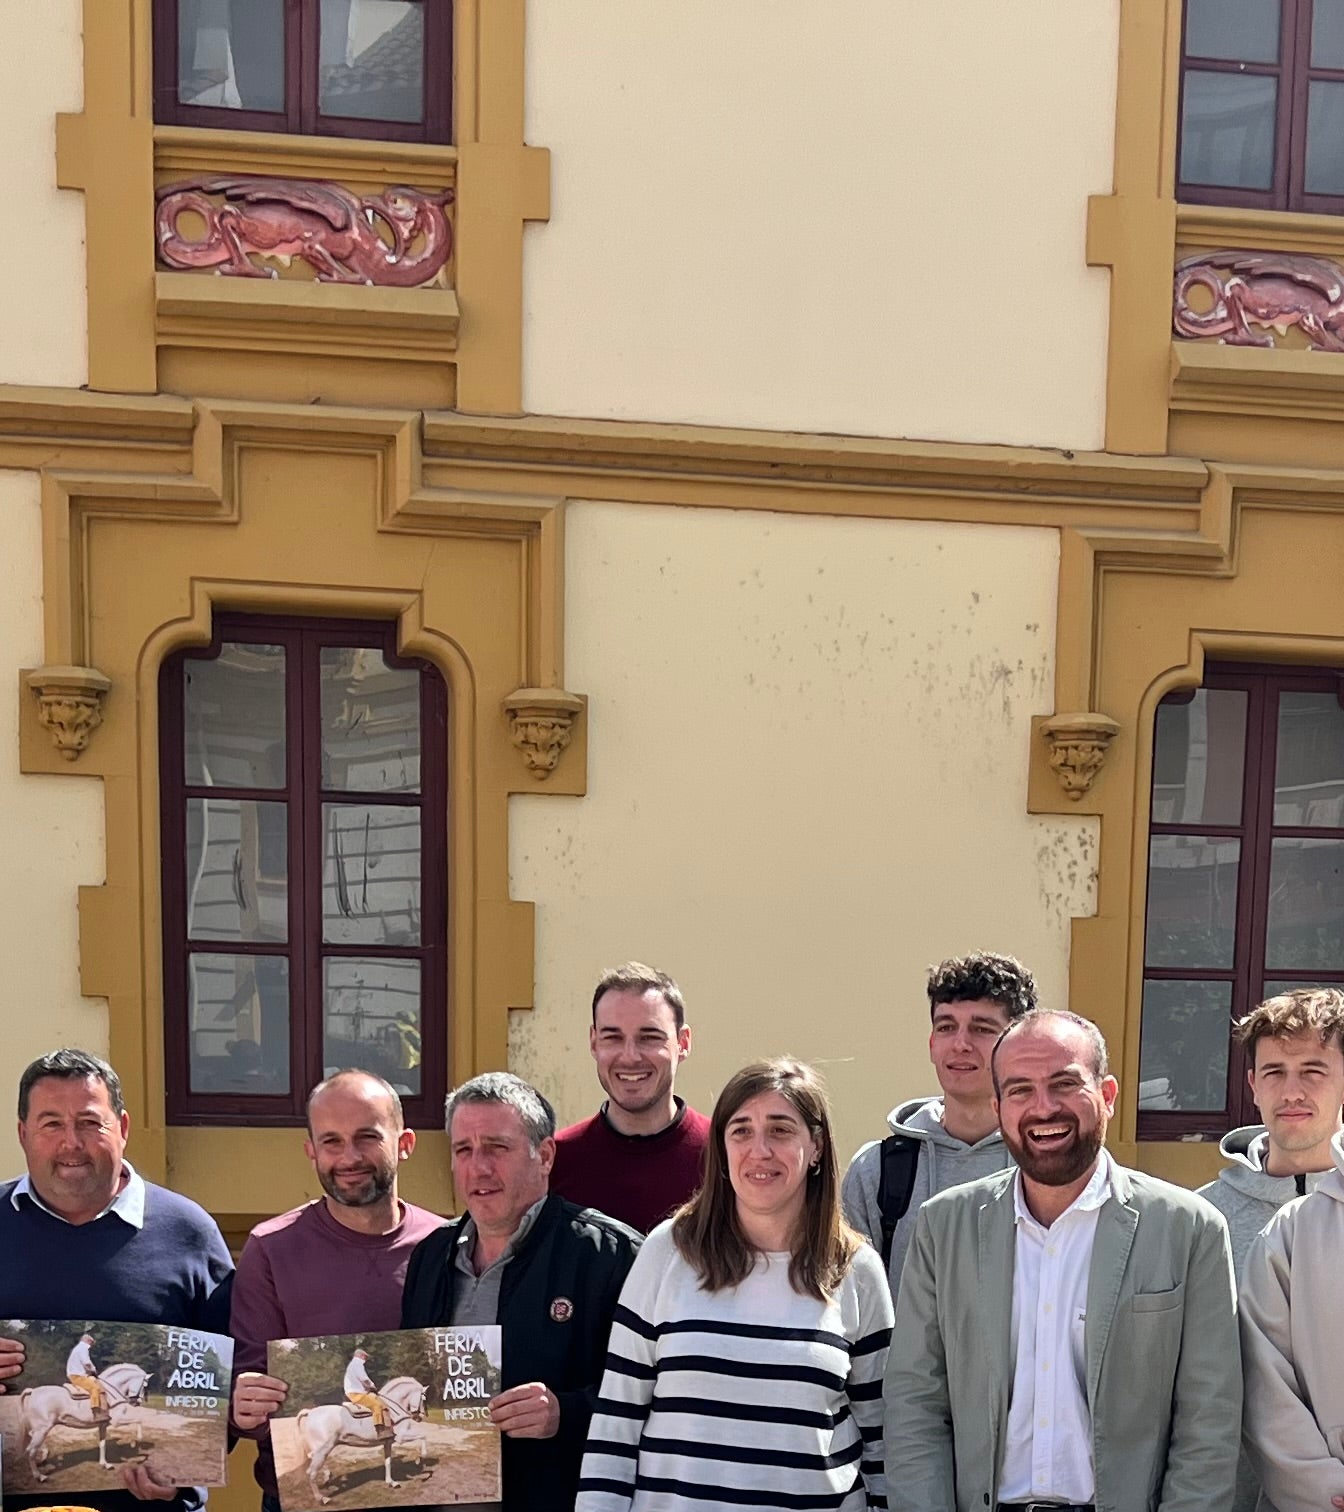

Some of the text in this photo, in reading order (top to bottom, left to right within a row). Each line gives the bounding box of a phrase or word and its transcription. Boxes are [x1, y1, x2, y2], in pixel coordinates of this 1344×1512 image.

[167, 1331, 217, 1353] FERIA
[434, 1332, 485, 1354] FERIA
[178, 1350, 205, 1370] DE
[447, 1355, 473, 1377] DE
[167, 1369, 220, 1391] ABRIL
[442, 1377, 491, 1401] ABRIL
